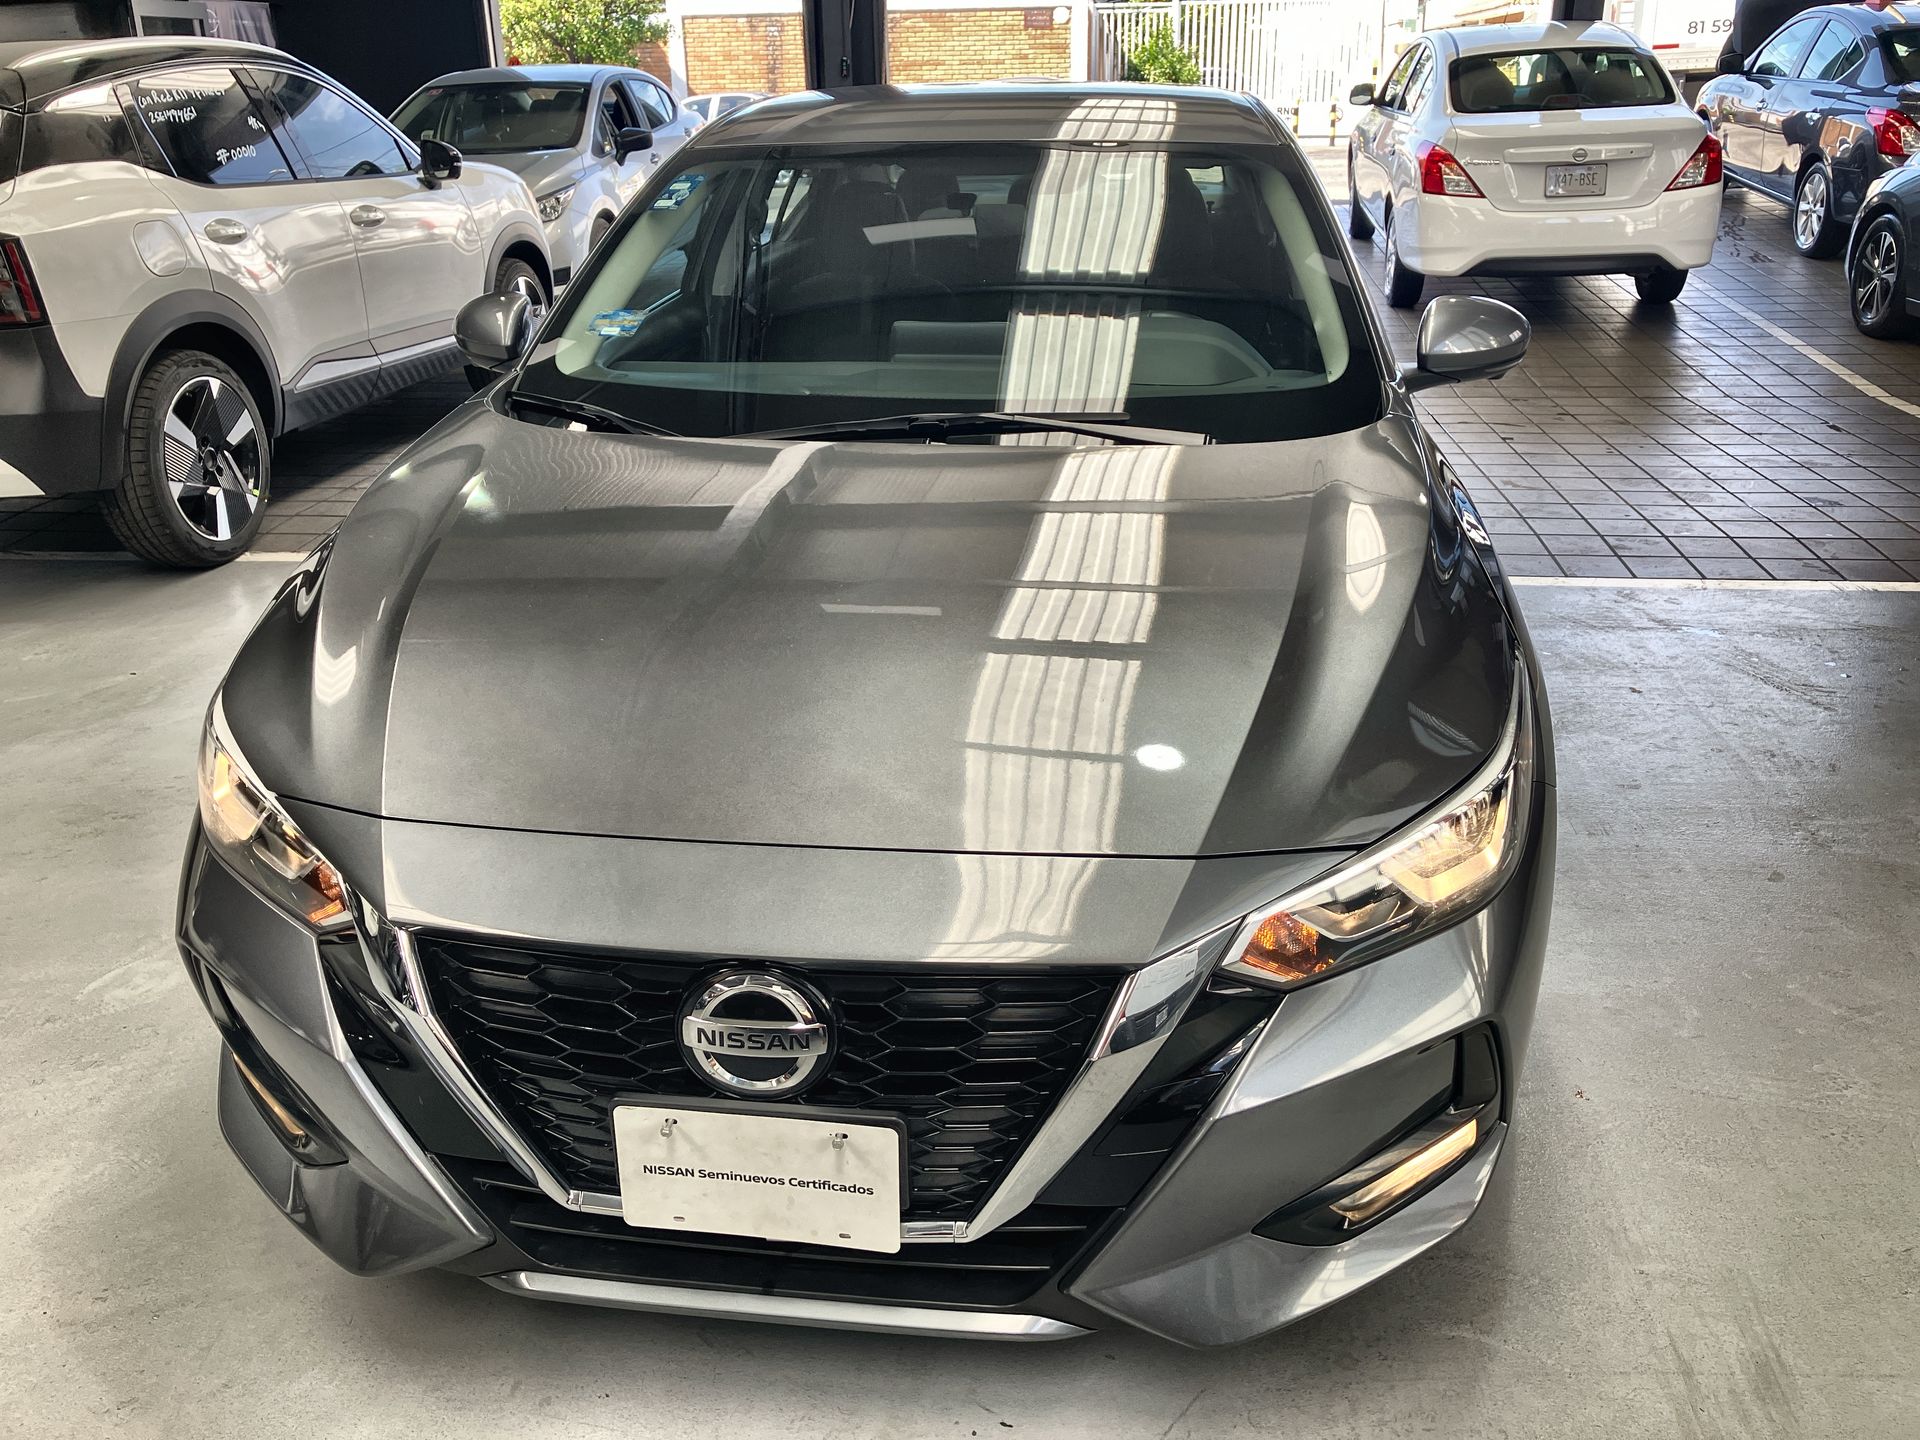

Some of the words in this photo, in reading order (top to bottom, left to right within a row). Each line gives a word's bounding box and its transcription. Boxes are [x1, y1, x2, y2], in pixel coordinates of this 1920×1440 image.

[1687, 20, 1705, 35] 81
[1710, 18, 1733, 33] 59
[697, 1026, 811, 1051] NISSAN
[643, 1164, 695, 1178] NISSAN
[697, 1168, 786, 1187] Seminuevos
[788, 1177, 875, 1196] Certificados
